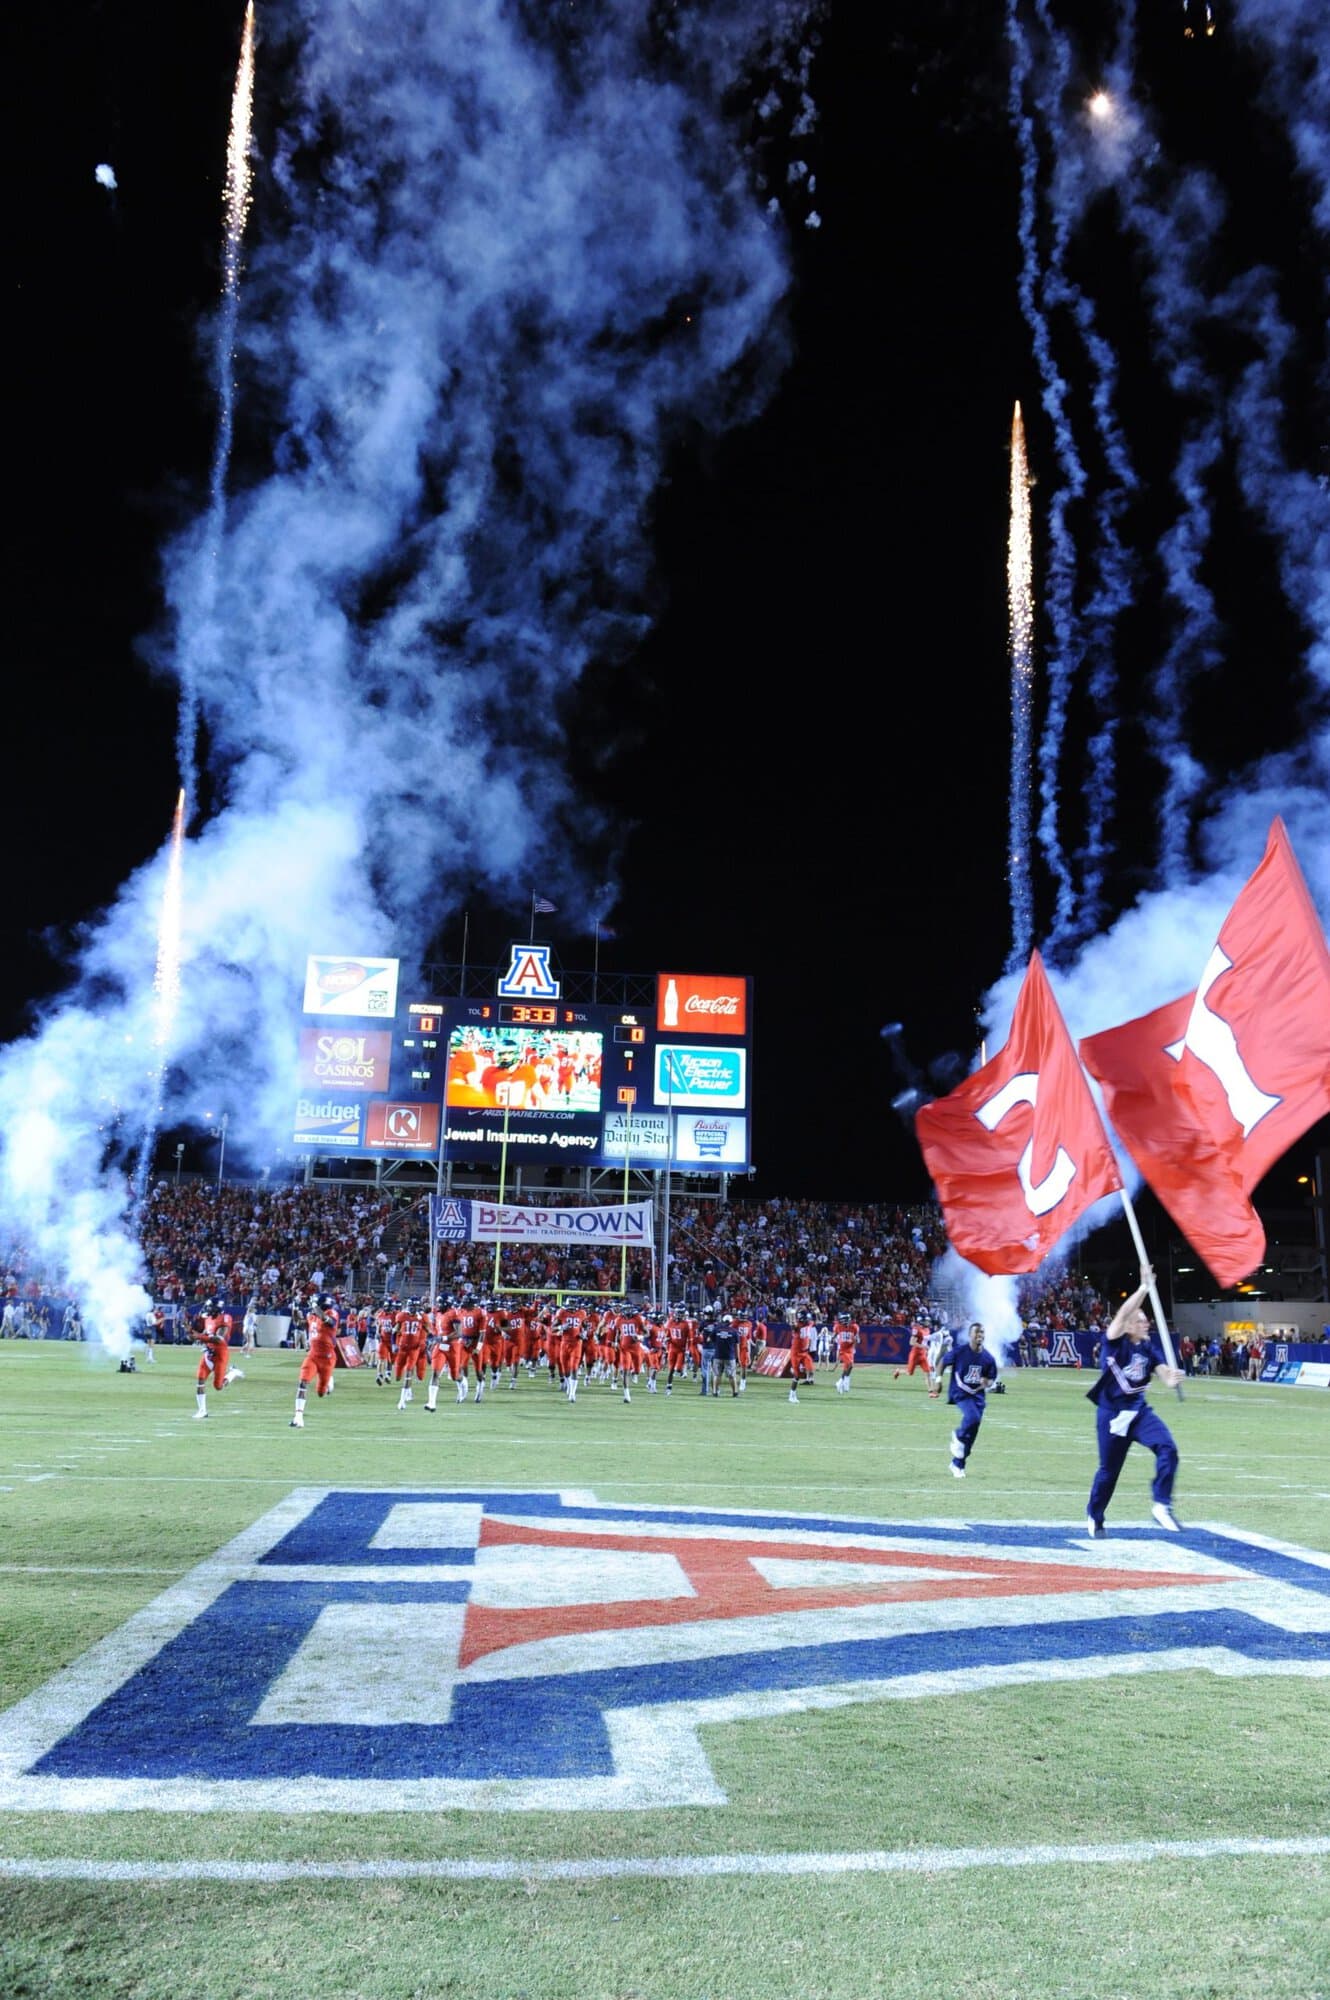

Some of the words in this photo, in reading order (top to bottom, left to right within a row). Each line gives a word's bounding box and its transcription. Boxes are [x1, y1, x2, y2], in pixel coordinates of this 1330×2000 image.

[498, 945, 560, 1000] A
[468, 1008, 481, 1016] TOL
[482, 1007, 490, 1018] 3
[512, 1007, 556, 1023] 3:33
[565, 1011, 574, 1022] 3
[575, 1013, 588, 1021] TOL
[421, 1018, 433, 1031] 0
[631, 1028, 644, 1042] 0
[315, 1035, 375, 1066] SOL
[681, 1054, 722, 1068] Tucson
[313, 1063, 375, 1078] CASINOS
[683, 1065, 733, 1079] Electric
[689, 1077, 733, 1090] Power
[296, 1100, 361, 1123] Budget
[613, 1115, 664, 1130] Arizona
[444, 1128, 484, 1142] Jewell
[487, 1129, 548, 1145] Insurance
[549, 1132, 598, 1149] Agency
[604, 1130, 640, 1145] Daily
[643, 1131, 672, 1144] Star
[436, 1199, 467, 1227] A
[436, 1228, 466, 1238] CLUB
[1048, 1332, 1081, 1365] A
